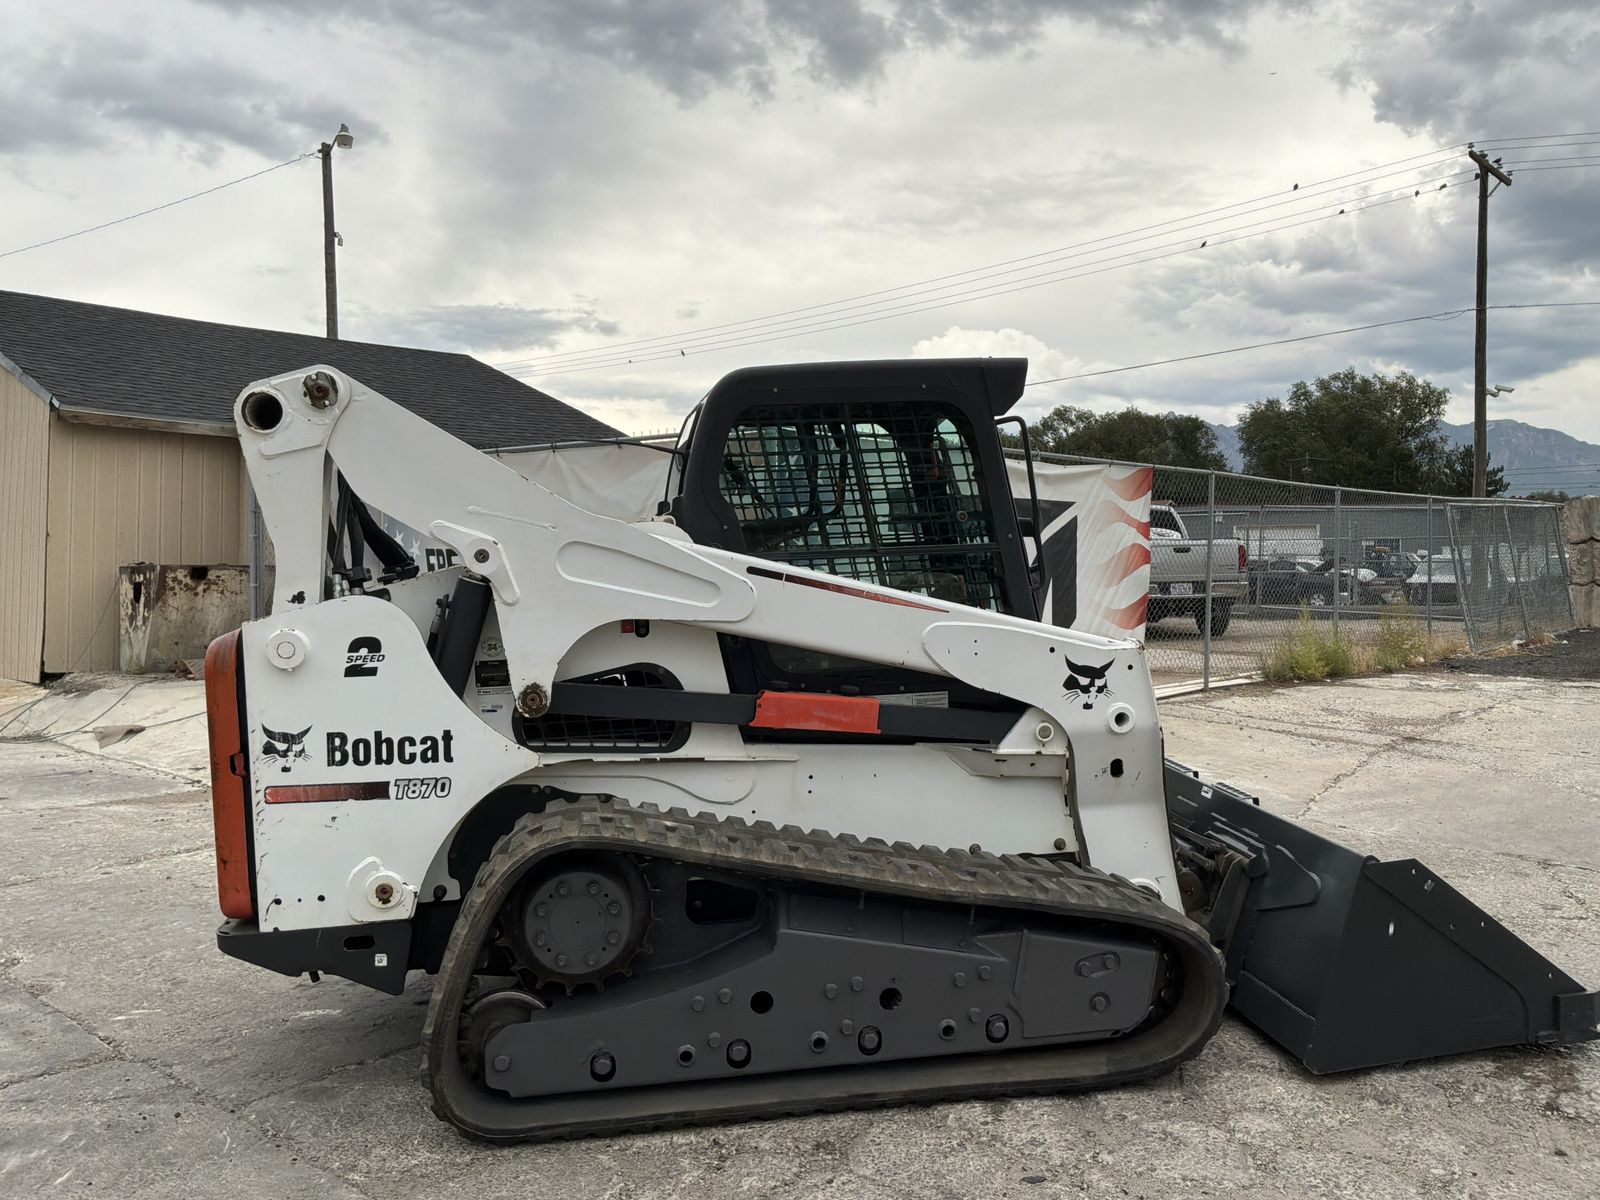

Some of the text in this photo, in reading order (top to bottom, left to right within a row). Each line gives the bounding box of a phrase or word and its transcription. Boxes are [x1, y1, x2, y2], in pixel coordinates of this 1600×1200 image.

[344, 636, 382, 677] 2
[346, 654, 385, 663] SPEED
[326, 730, 454, 767] Bobcat
[394, 776, 452, 800] T870
